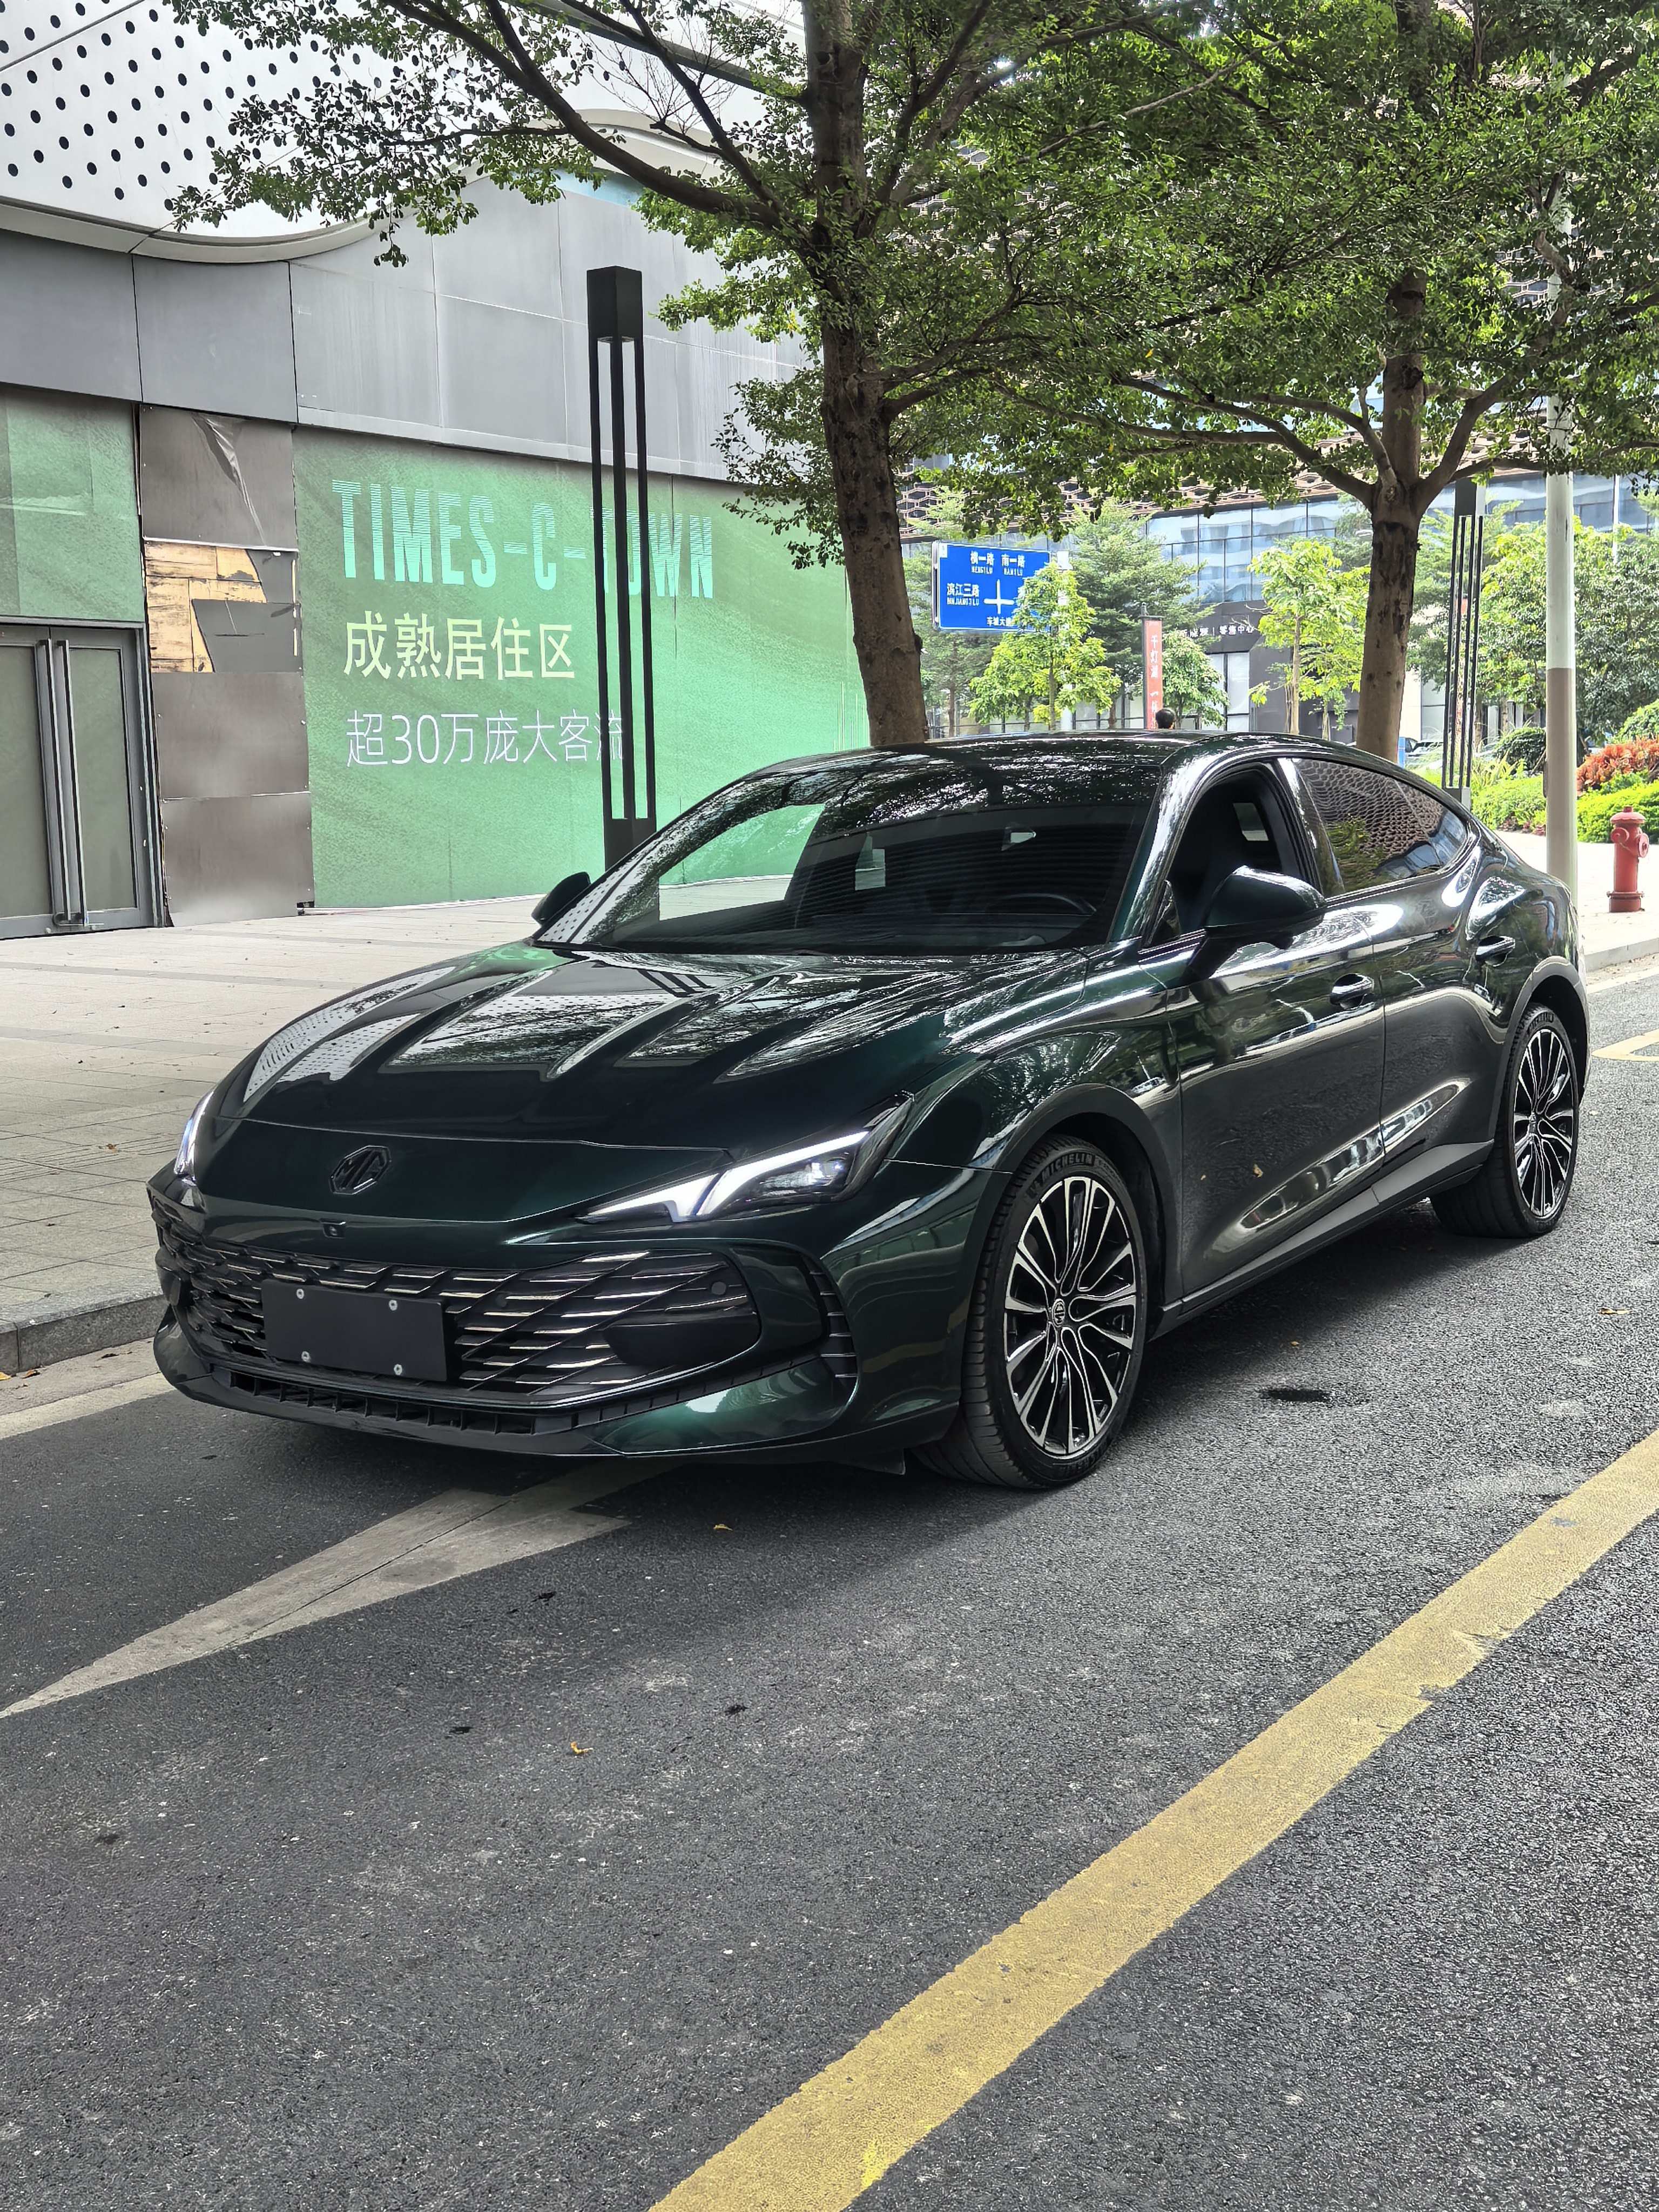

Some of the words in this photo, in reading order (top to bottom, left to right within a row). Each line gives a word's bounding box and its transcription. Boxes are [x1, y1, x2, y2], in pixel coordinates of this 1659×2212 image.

[947, 583, 980, 597] 滨江三路
[343, 610, 575, 680] 成熟居住区
[346, 709, 625, 767] 超30万庞大客流
[331, 1145, 388, 1193] MG
[1041, 1152, 1094, 1182] MICHELIN
